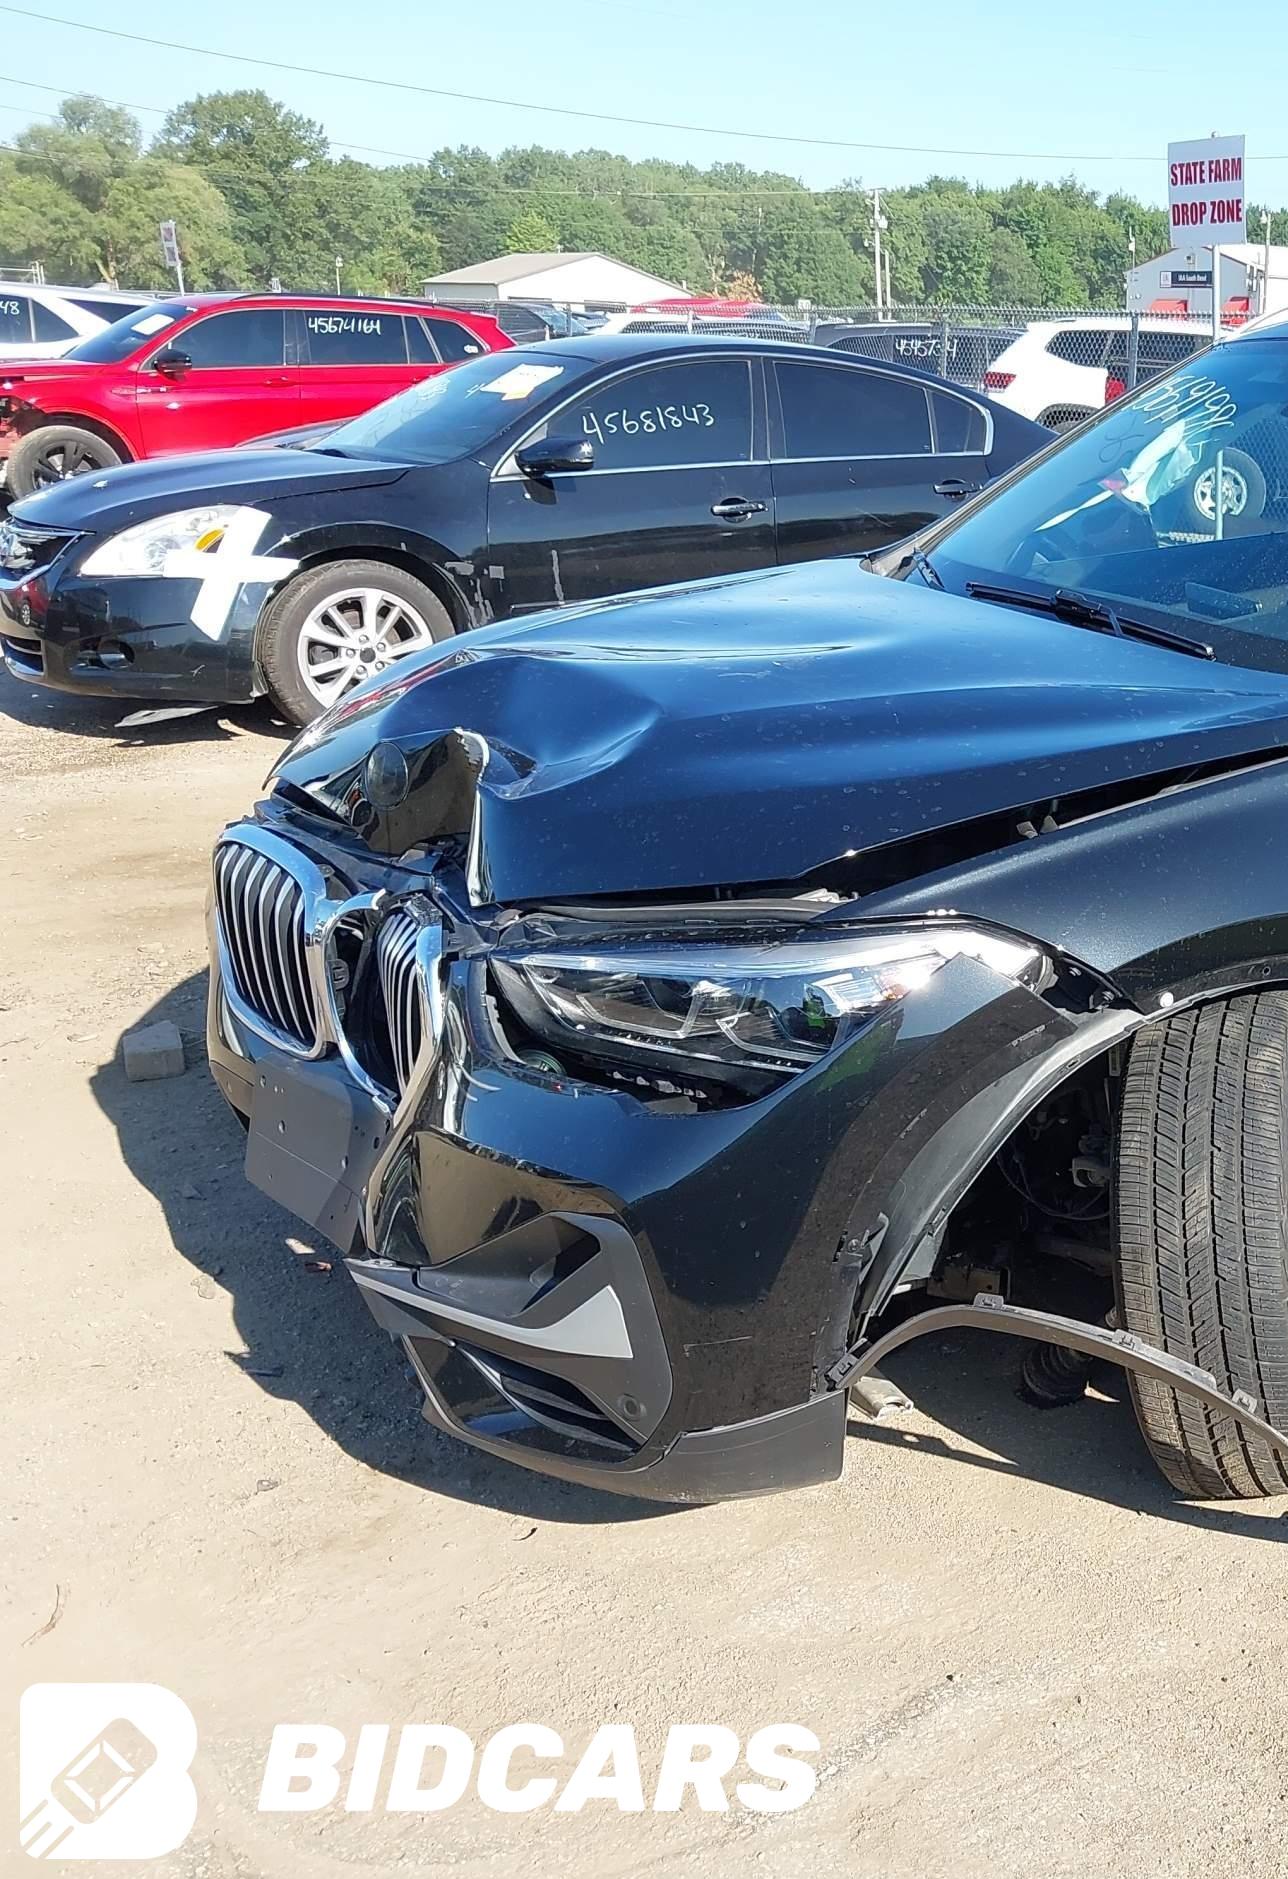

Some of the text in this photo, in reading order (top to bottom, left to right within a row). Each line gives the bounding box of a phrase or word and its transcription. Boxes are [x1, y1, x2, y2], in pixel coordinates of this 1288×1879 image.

[1170, 157, 1242, 187] STATE FARM
[1172, 198, 1243, 226] DROP ZONE
[308, 317, 381, 335] 45674164
[582, 404, 715, 444] 45681843
